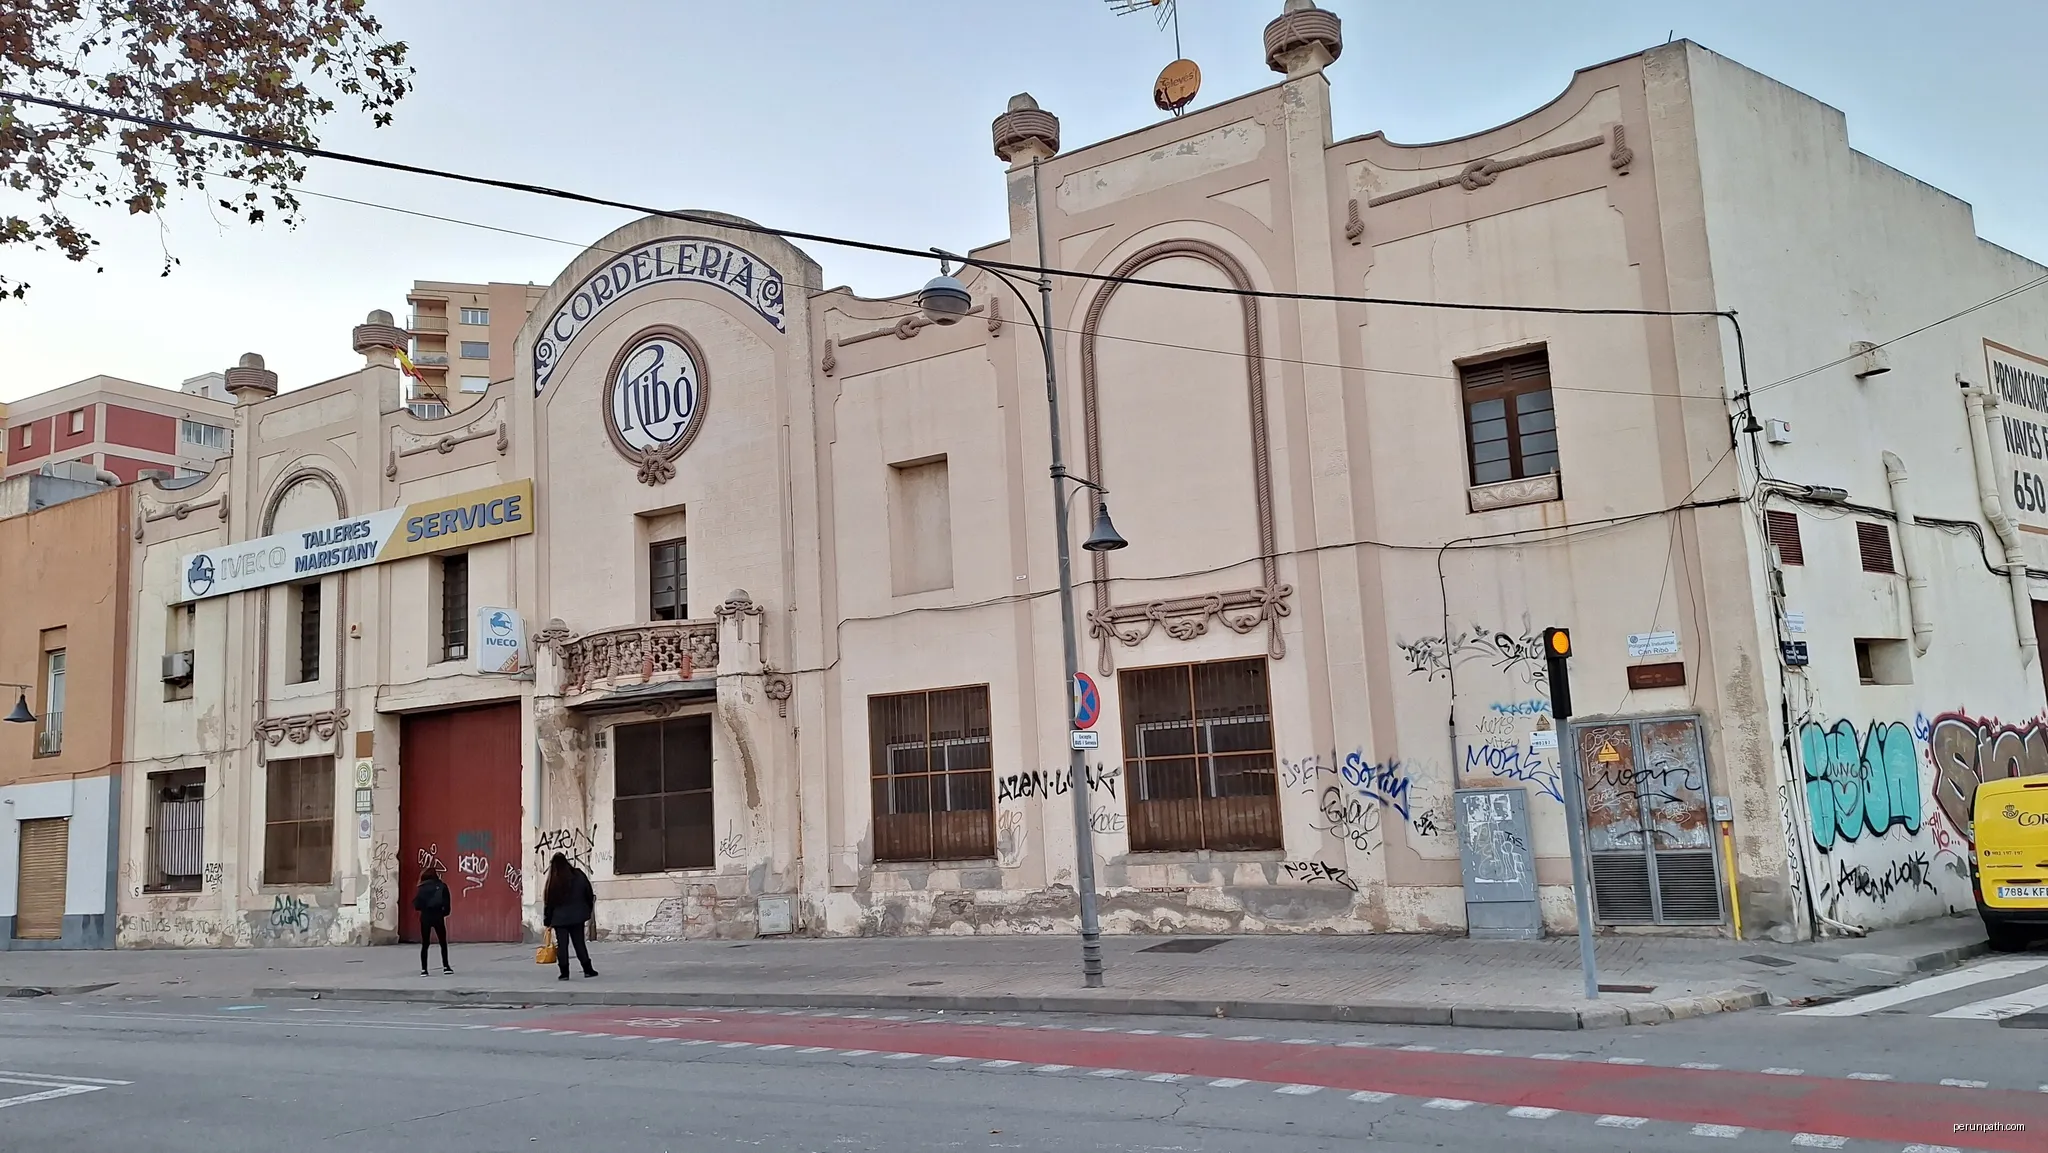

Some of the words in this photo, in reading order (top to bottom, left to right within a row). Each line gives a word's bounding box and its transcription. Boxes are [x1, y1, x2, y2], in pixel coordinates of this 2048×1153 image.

[618, 344, 692, 442] Ribó
[2002, 415, 2042, 460] NAVES
[2014, 470, 2046, 514] 650
[302, 520, 370, 549] TALLERES
[406, 495, 522, 542] SERVICE
[221, 546, 286, 581] IVECO
[294, 540, 378, 573] MARISTANY
[486, 637, 517, 647] IVECO
